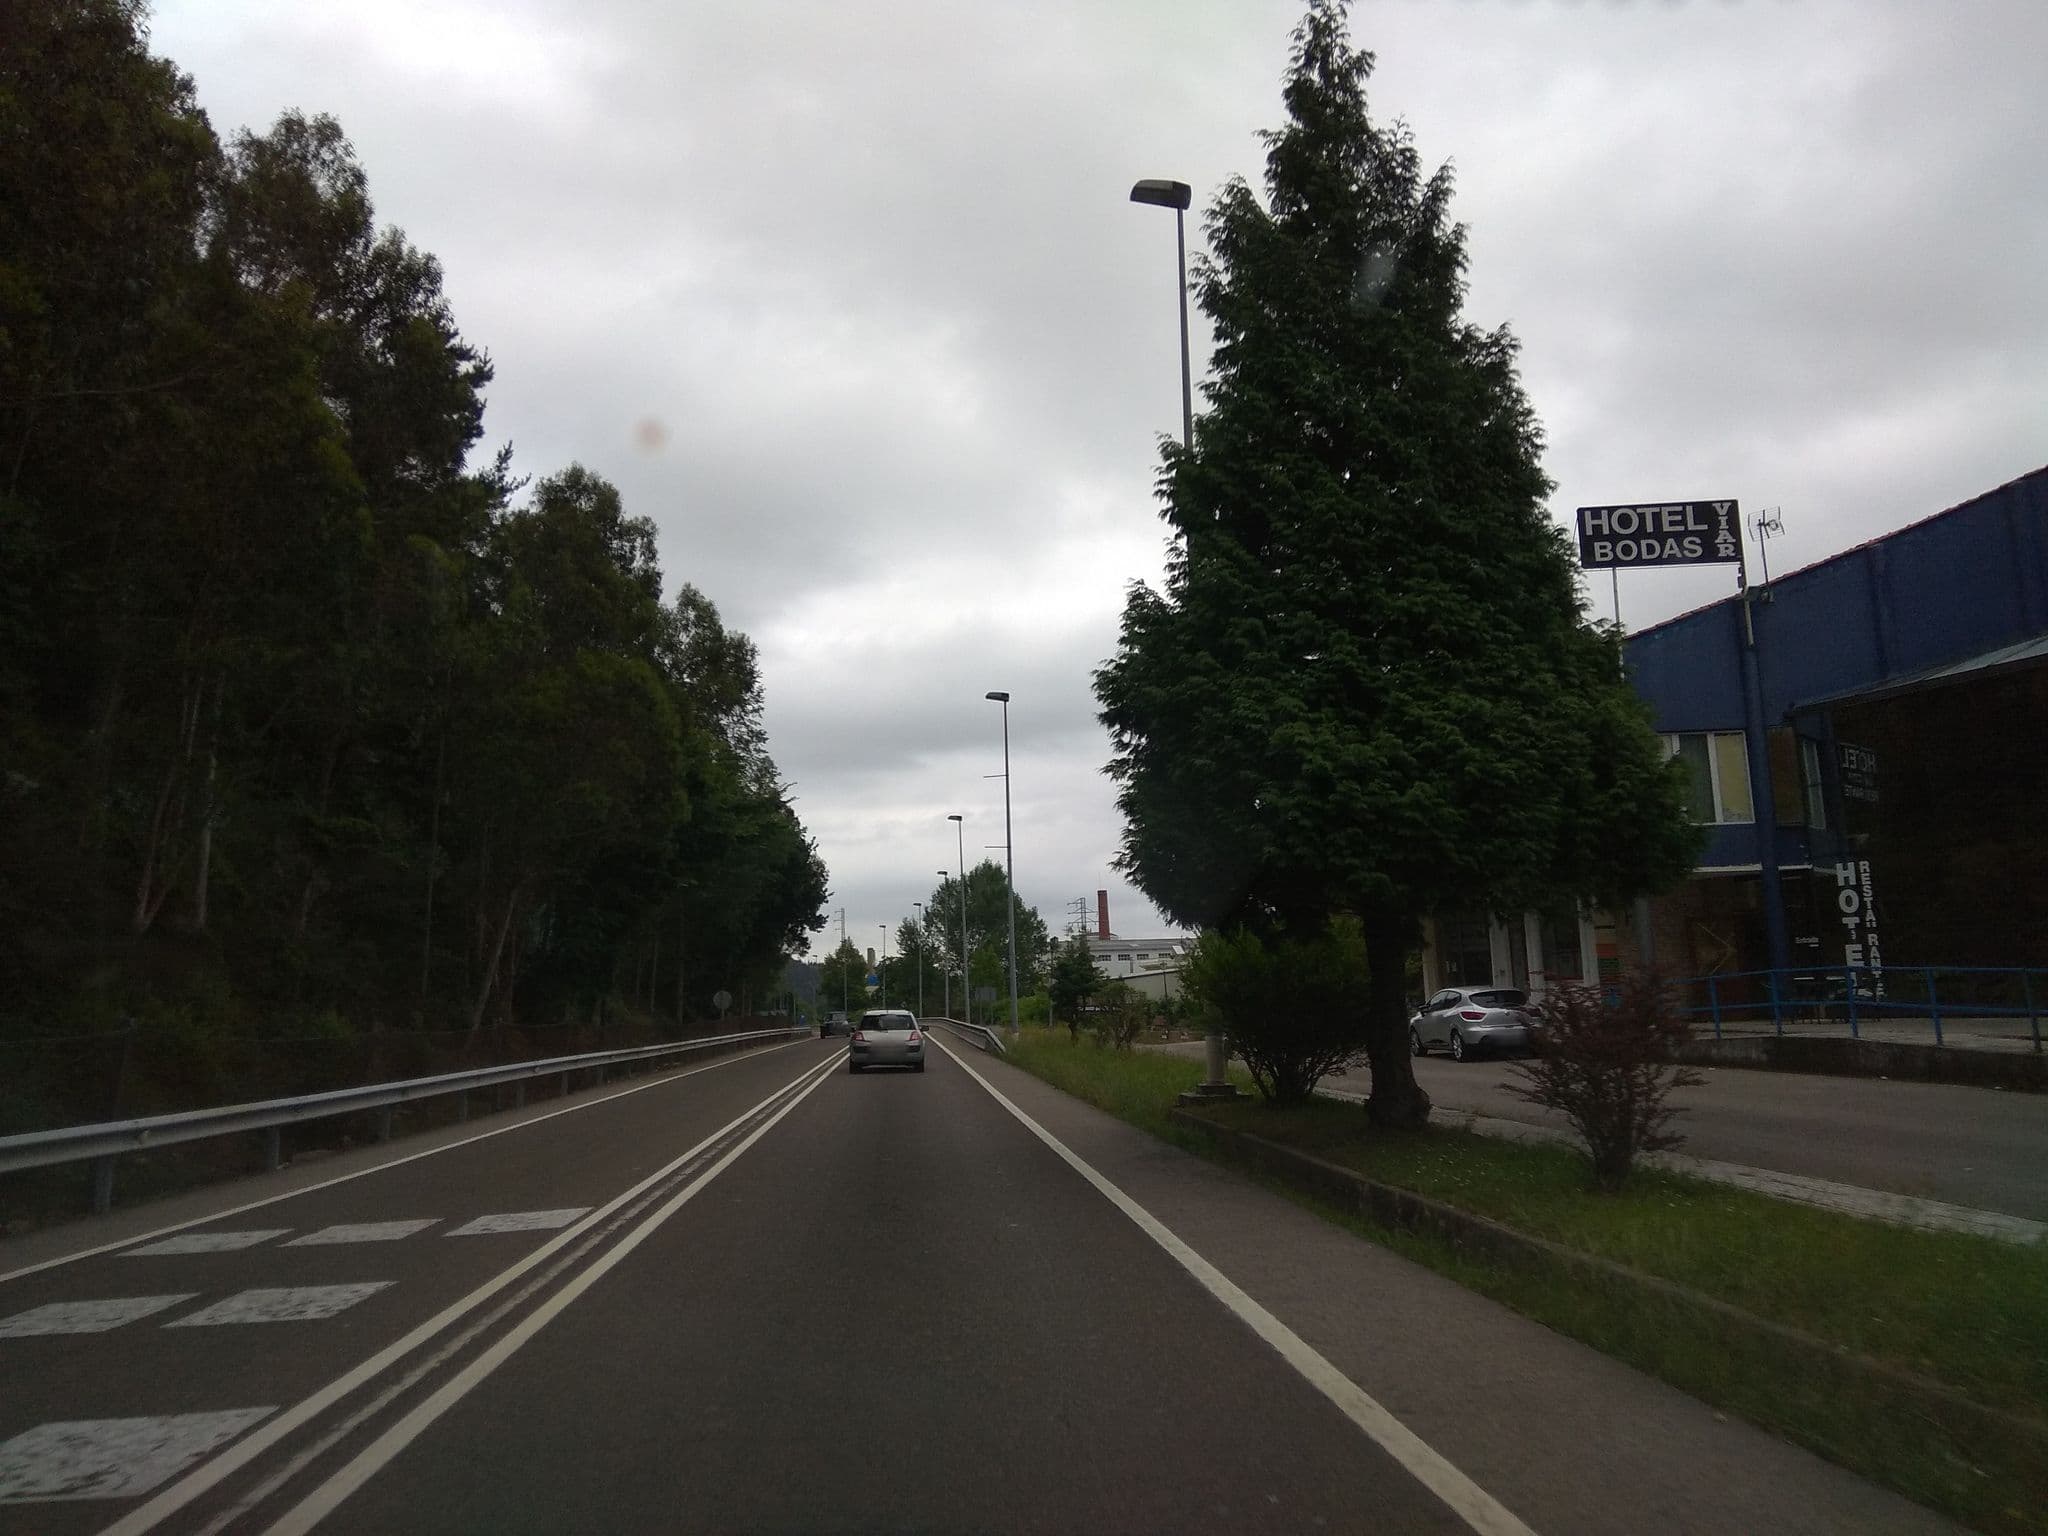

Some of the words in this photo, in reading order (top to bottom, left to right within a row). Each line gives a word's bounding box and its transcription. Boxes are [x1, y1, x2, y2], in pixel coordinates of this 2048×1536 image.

[1584, 505, 1708, 536] HOTEL
[1712, 502, 1736, 557] VIAR
[1594, 537, 1703, 562] BODAS
